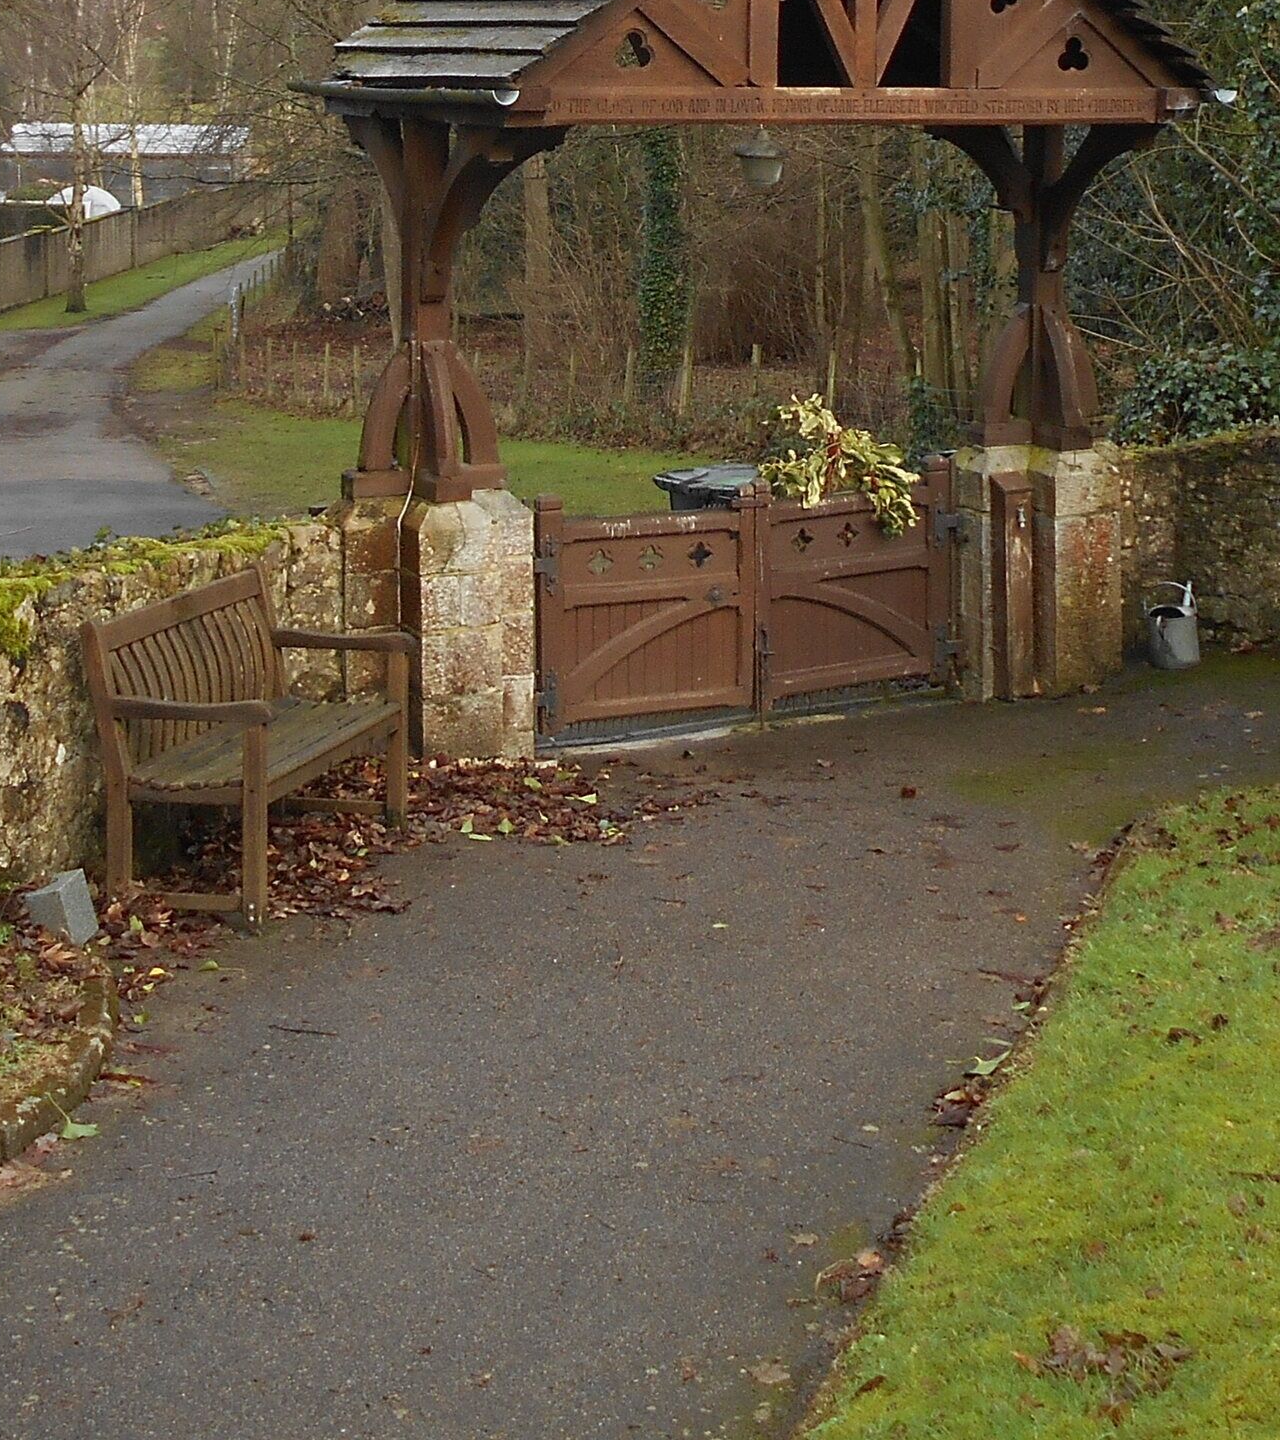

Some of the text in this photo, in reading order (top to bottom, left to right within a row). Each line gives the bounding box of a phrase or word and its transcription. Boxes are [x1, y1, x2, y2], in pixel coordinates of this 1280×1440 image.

[567, 98, 591, 114] THE
[641, 98, 657, 114] OF
[661, 98, 683, 114] GOD
[688, 98, 710, 114] AND
